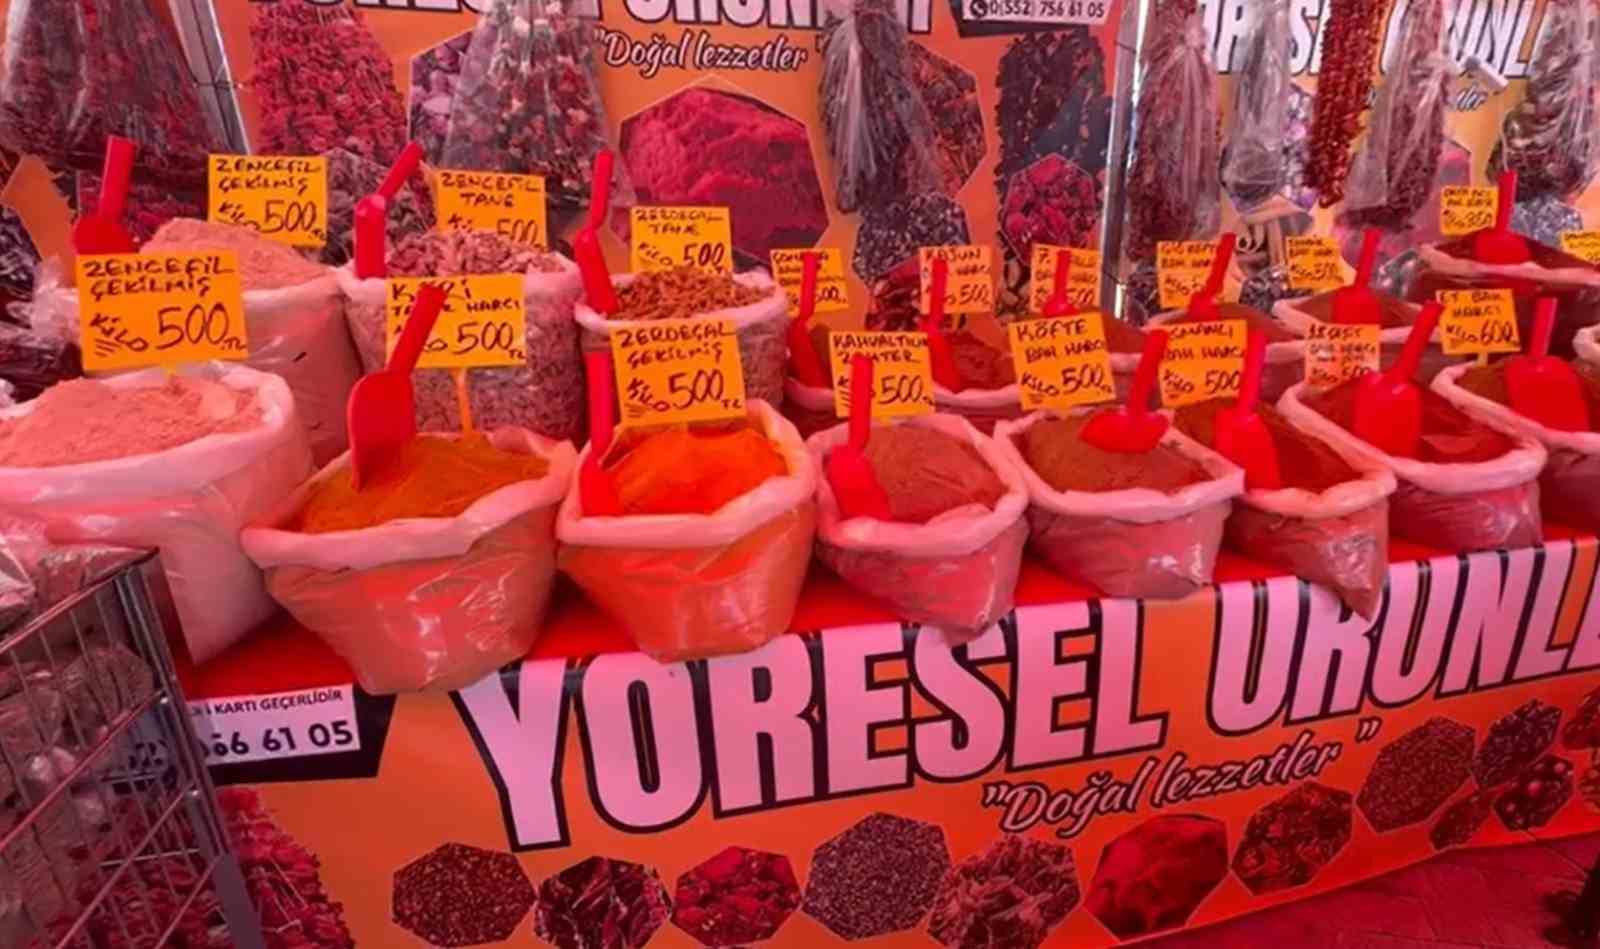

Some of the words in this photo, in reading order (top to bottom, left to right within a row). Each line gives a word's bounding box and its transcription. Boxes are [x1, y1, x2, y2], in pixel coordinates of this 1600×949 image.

[1039, 1, 1065, 17] 756
[1068, 2, 1083, 17] 61
[1087, 2, 1105, 18] 05
[692, 29, 808, 71] lezzetler
[260, 199, 318, 234] 500
[683, 241, 725, 268] 500
[959, 283, 990, 305] 500
[155, 302, 230, 351] 500
[452, 320, 514, 355] 500
[1015, 318, 1087, 342] KÖFTE
[1480, 319, 1514, 347] 600
[669, 368, 725, 411] 500
[877, 374, 925, 405] 500
[1061, 363, 1105, 396] 500
[1204, 370, 1241, 394] 500
[214, 701, 257, 715] KARTI
[259, 688, 344, 711] GEÇERLİDİR
[261, 726, 297, 752] 61
[307, 719, 354, 749] 05
[1153, 730, 1344, 806] lezzetler
